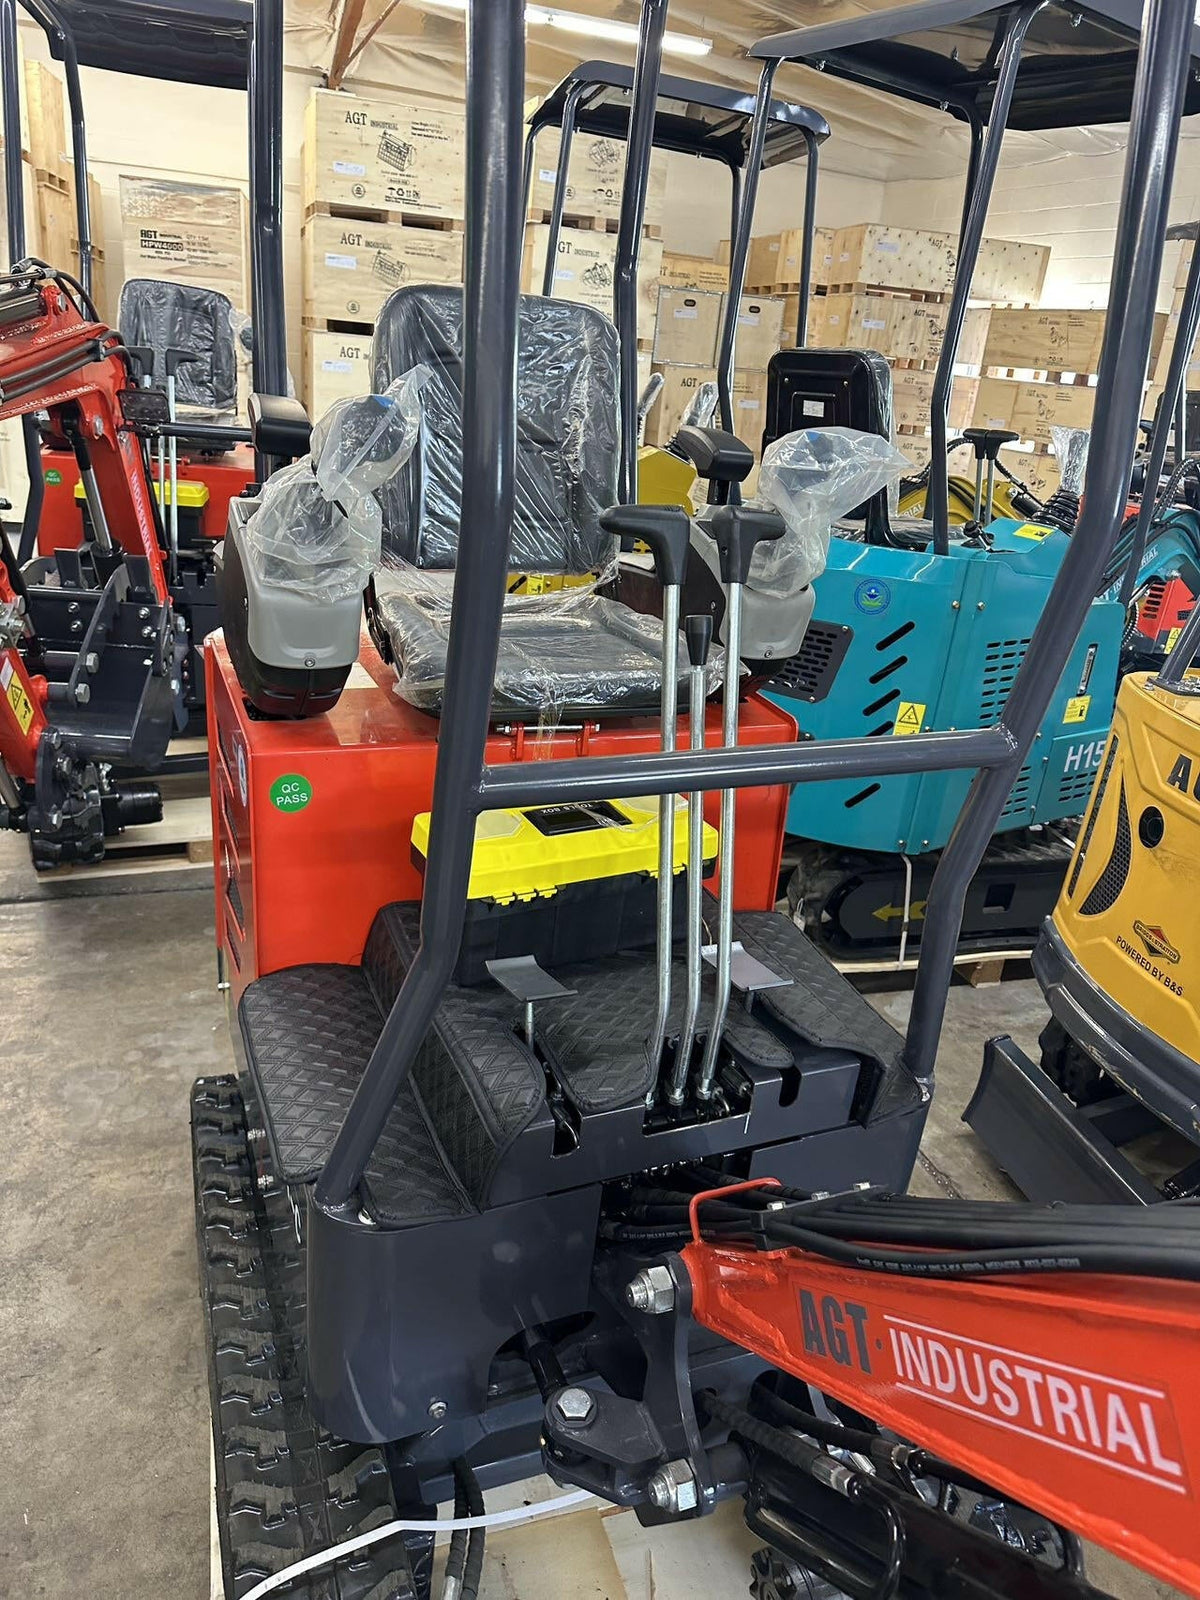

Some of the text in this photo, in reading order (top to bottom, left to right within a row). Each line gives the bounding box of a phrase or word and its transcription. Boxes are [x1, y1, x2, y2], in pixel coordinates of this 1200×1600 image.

[345, 110, 368, 126] AGT
[140, 229, 158, 239] AGT
[340, 232, 363, 246] AGT
[142, 240, 183, 251] HPW4000
[558, 241, 573, 254] GT
[340, 346, 361, 359] AGT
[680, 377, 697, 387] AGT
[1063, 740, 1107, 773] H15
[281, 782, 300, 794] QC
[276, 792, 308, 806] PASS
[541, 802, 592, 814] TOLS BOX
[1116, 935, 1184, 997] POWERED BY B&S
[798, 1289, 1182, 1477] AGT INDUSTRIAL
